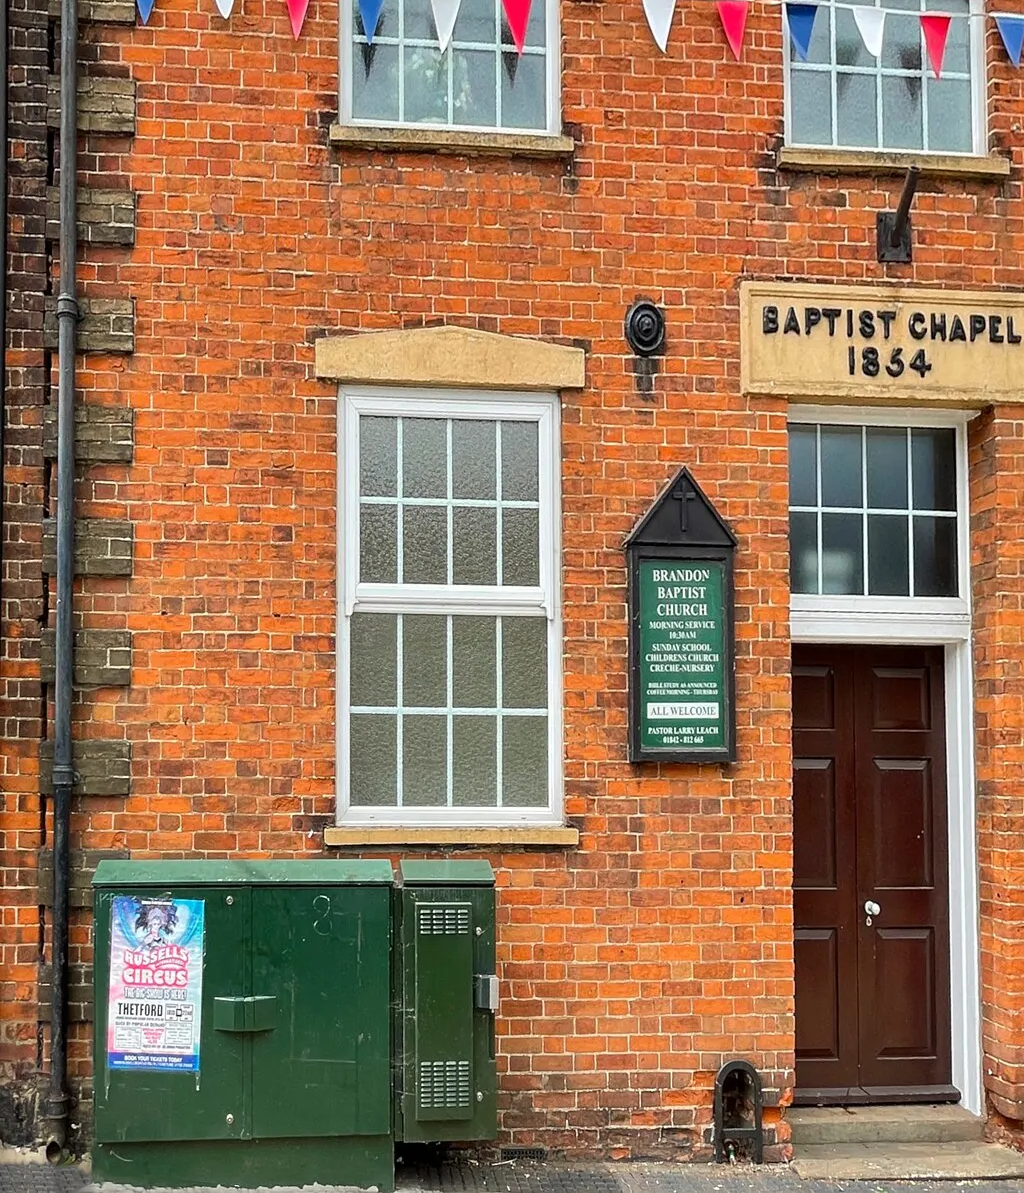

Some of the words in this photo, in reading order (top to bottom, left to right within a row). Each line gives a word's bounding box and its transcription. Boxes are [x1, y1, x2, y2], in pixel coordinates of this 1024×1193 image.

[763, 306, 897, 339] BAPTIST
[908, 312, 1023, 344] CHAPEL
[848, 345, 932, 378] 1854
[653, 570, 710, 582] BRANDON
[657, 587, 707, 599] BAPTIST
[656, 604, 708, 616] CHURCH
[649, 621, 684, 630] MORNING
[685, 621, 716, 629] SERVICE
[669, 631, 697, 639] 10:30AM
[651, 644, 681, 652] SUNDAY
[682, 644, 712, 652] SCHOOL
[645, 654, 687, 662] CHILDRENS
[688, 654, 719, 662] CHURCH
[650, 664, 715, 673] CRECHE-NURSERY
[651, 706, 669, 715] ALL
[670, 706, 716, 715] WELCOME
[648, 727, 673, 735] PASTOR
[674, 727, 695, 735] LARRY
[696, 727, 719, 735] LEACH
[124, 946, 188, 965] RUSSELLS
[123, 968, 188, 986] CIRCUS
[124, 987, 135, 998] THE
[146, 988, 163, 1000] SHOW
[118, 1003, 163, 1017] THETFORD
